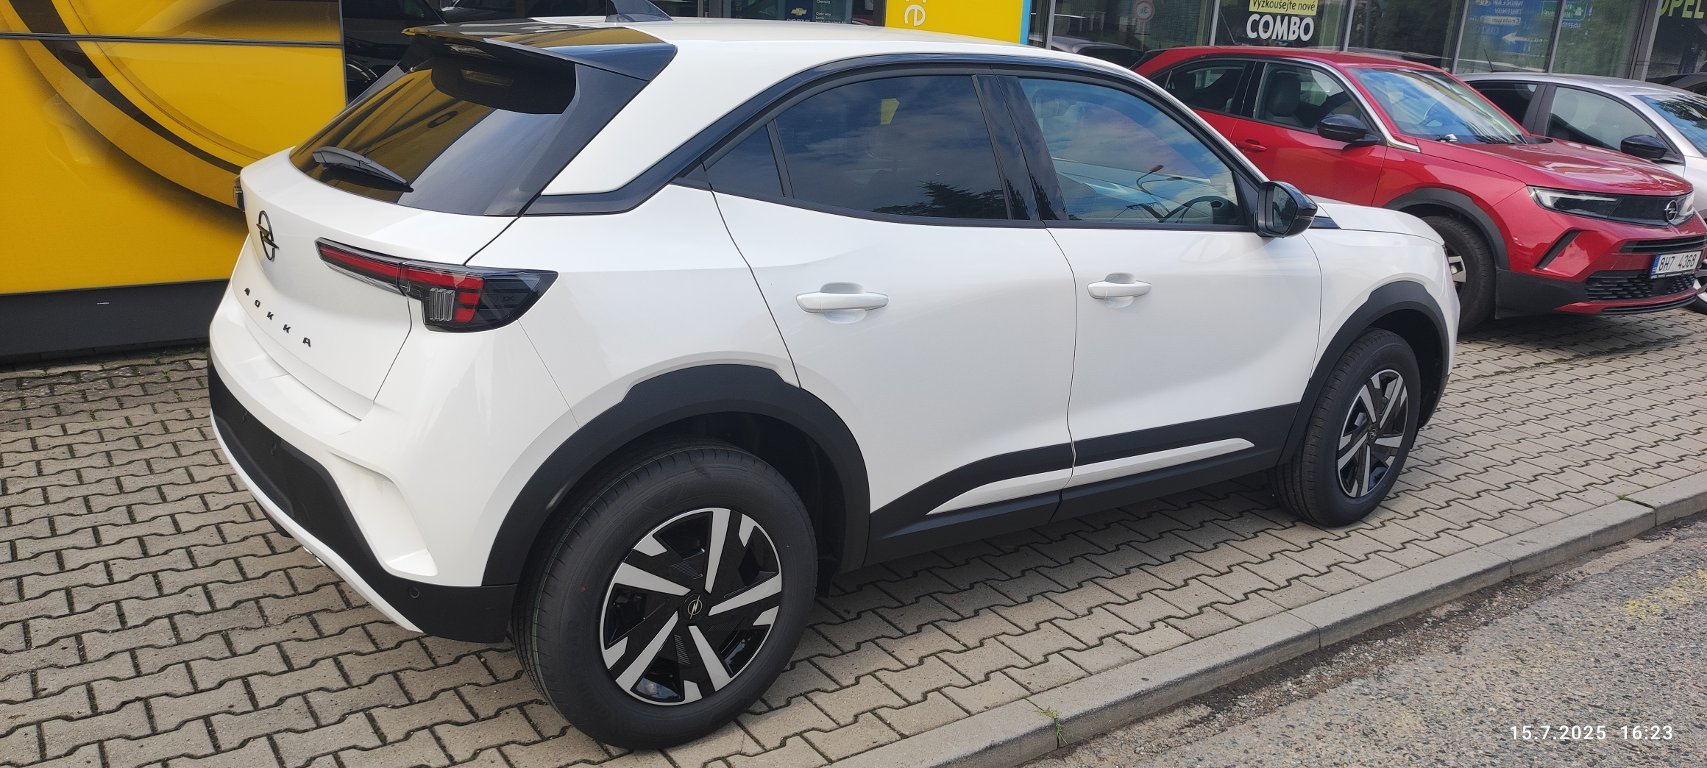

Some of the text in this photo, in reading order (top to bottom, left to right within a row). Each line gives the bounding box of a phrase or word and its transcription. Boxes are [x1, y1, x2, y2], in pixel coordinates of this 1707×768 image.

[1253, 0, 1316, 11] Vyzkoušejte nové
[1246, 13, 1314, 42] COMBO
